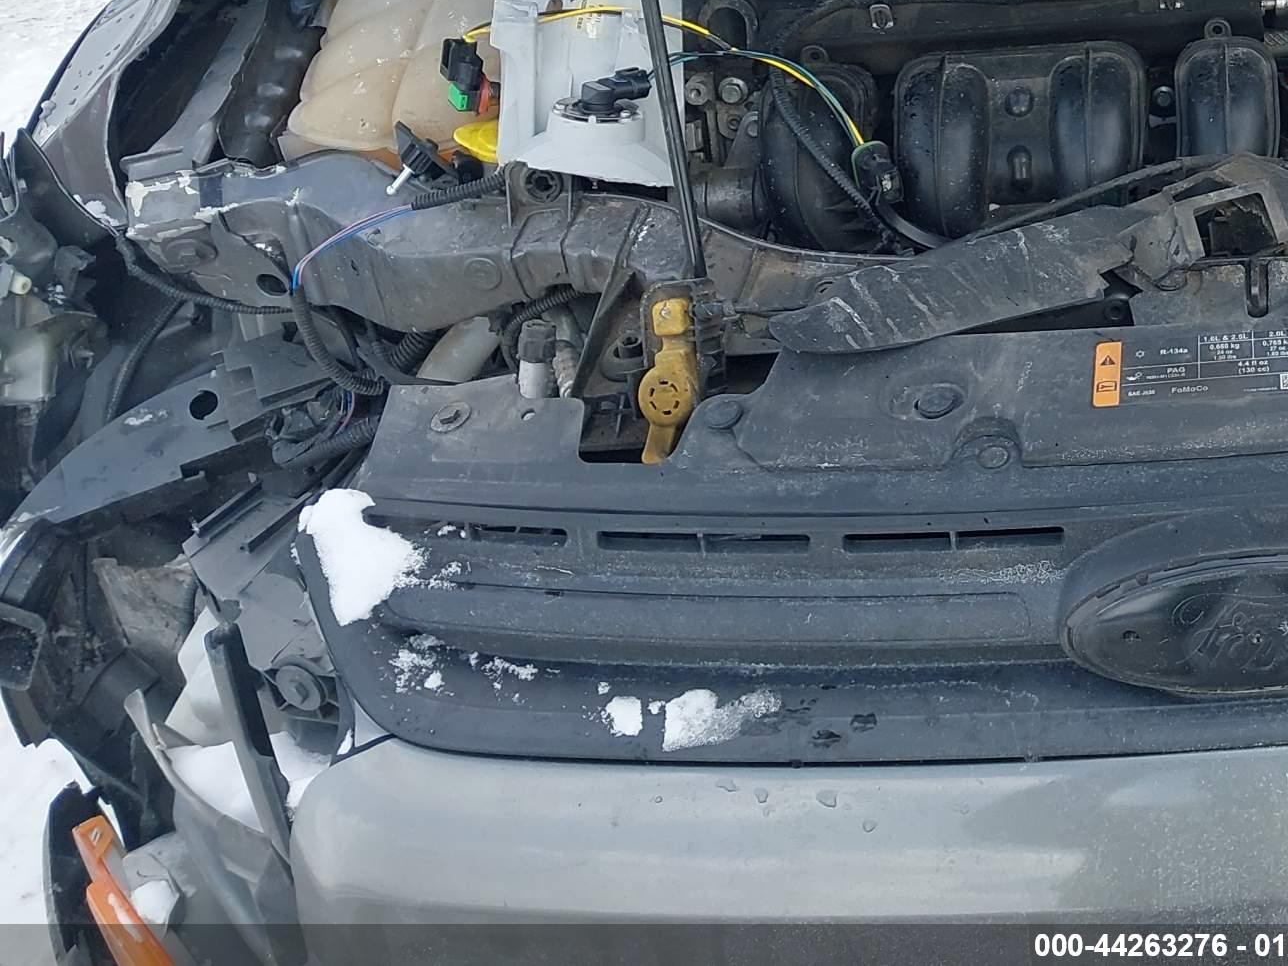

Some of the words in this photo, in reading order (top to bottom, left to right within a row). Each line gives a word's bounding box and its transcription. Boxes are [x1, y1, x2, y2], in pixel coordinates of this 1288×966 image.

[1230, 342, 1240, 350] kg
[1160, 347, 1189, 356] R-134a
[1171, 385, 1209, 394] FoMoCo
